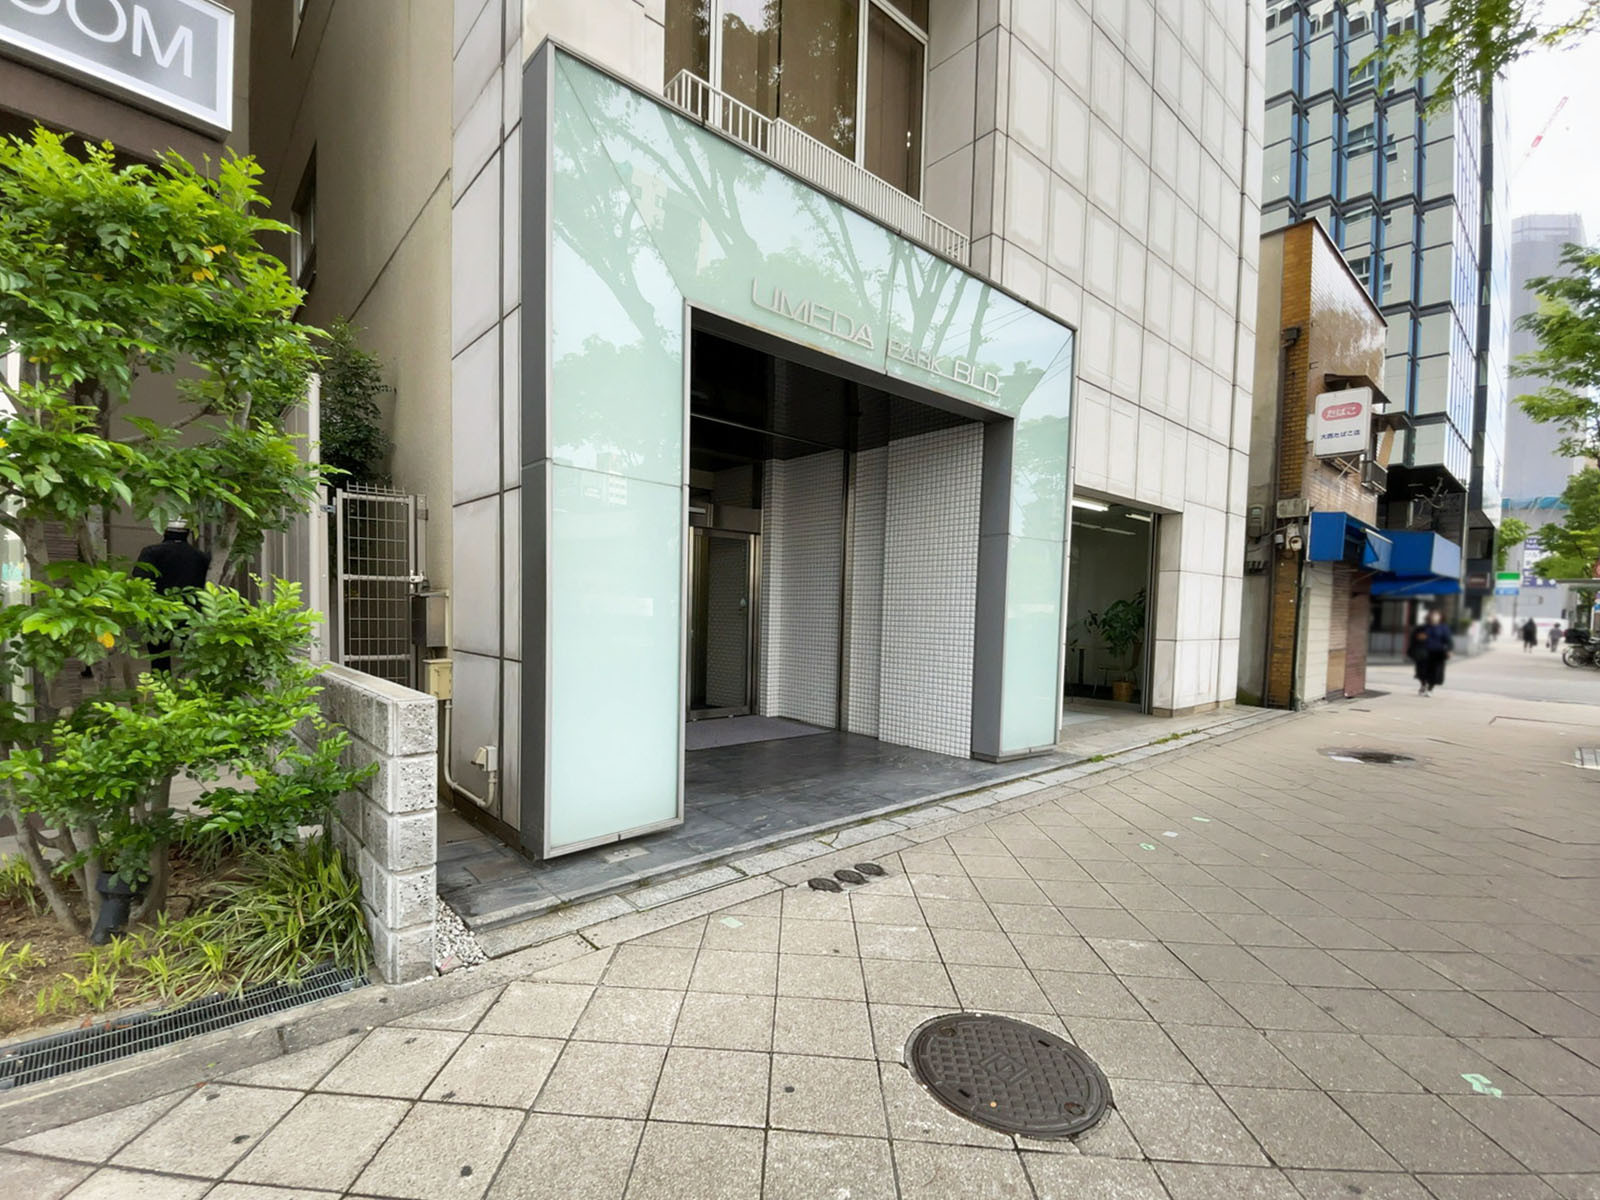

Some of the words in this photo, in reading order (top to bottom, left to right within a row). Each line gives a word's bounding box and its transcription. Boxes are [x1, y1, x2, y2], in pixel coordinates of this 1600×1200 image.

[8, 0, 193, 78] OM
[752, 276, 874, 350] UMEDA
[887, 339, 945, 375] PARK
[1326, 406, 1357, 419] たばこ
